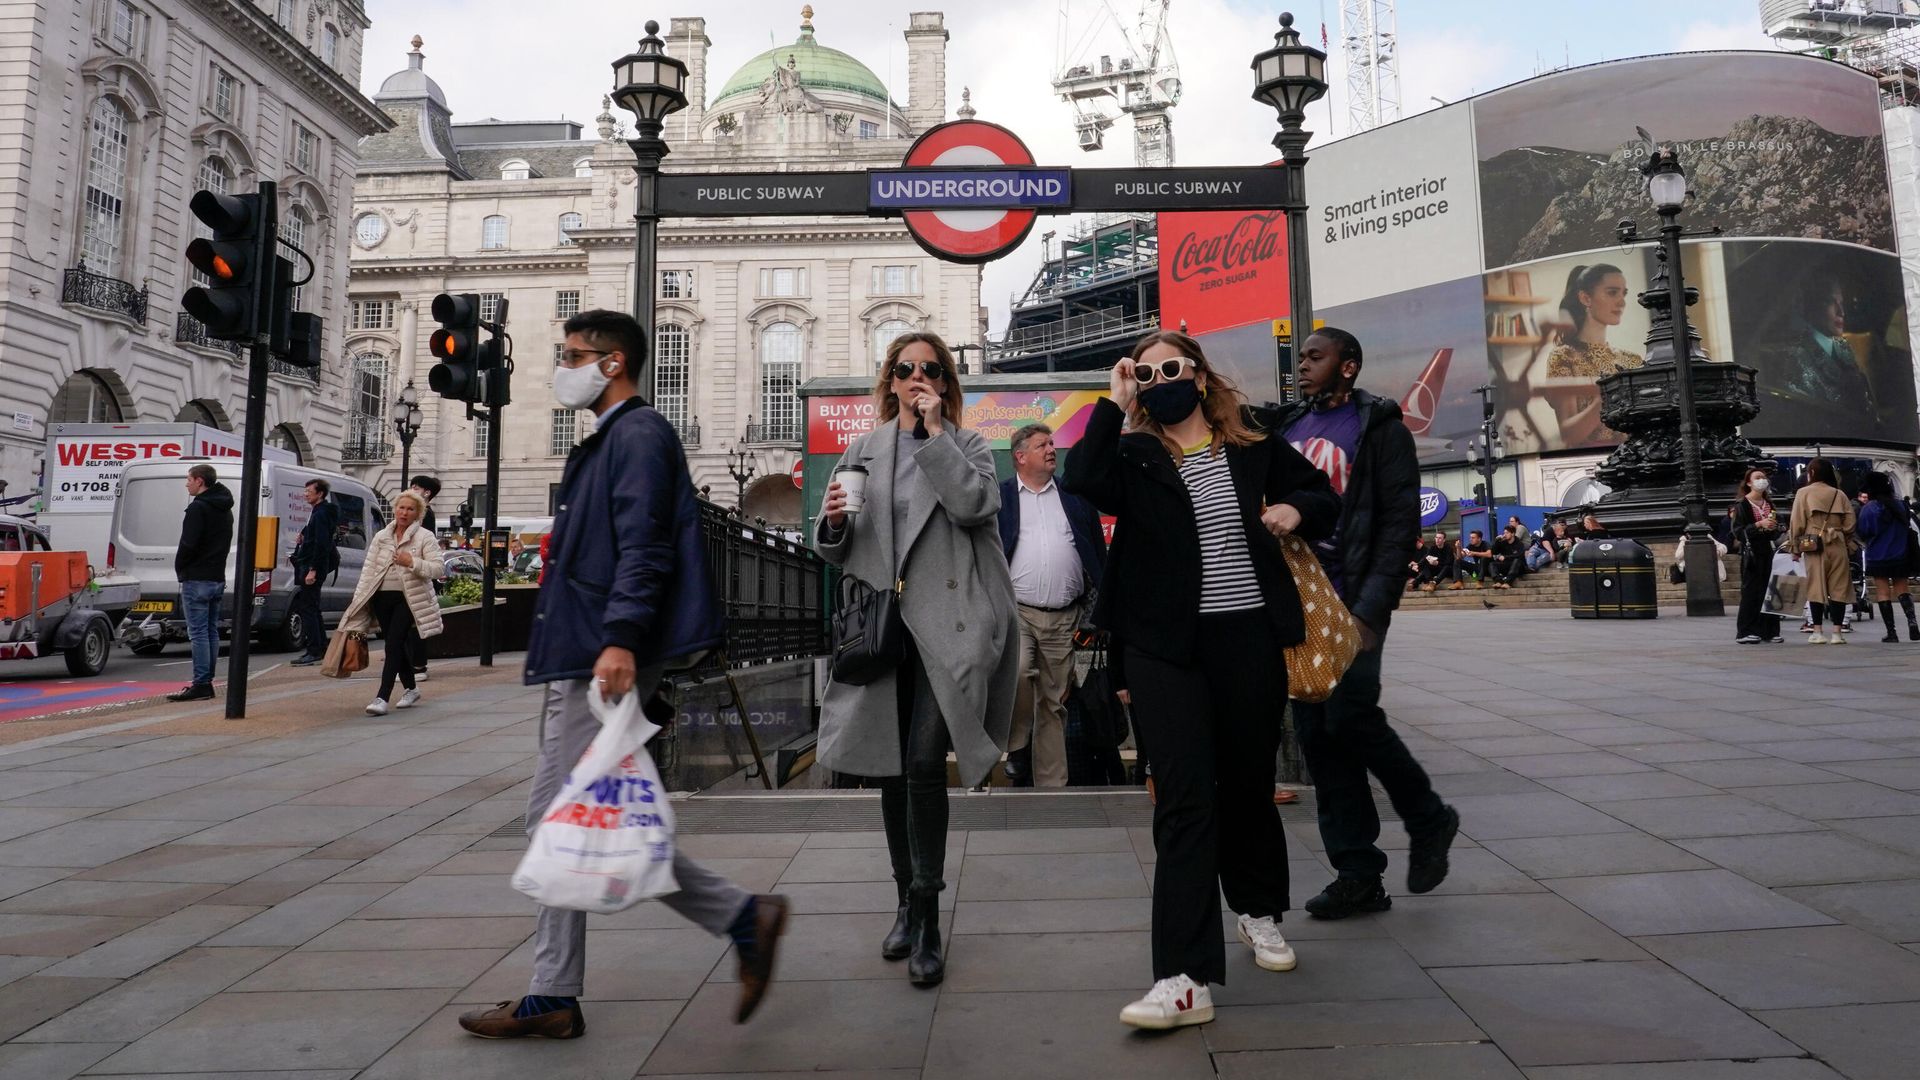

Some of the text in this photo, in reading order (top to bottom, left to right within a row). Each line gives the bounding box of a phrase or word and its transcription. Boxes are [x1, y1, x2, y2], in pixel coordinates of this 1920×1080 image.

[1676, 143, 1691, 153] IN
[1701, 141, 1718, 151] LE
[1727, 141, 1793, 151] BRASSUS
[697, 186, 825, 200] PUBLIC SUBWAY
[877, 178, 1062, 198] UNDERGROUND
[1115, 181, 1242, 195] PUBLIC SUBWAY
[1324, 177, 1447, 222] Smart interior
[1325, 200, 1449, 243] & living space
[1172, 210, 1279, 282] Coca-Cola
[1200, 270, 1257, 291] ZERO SUGAR
[820, 404, 880, 417] BUY YO
[57, 443, 182, 466] WESTS
[61, 482, 110, 492] 01708
